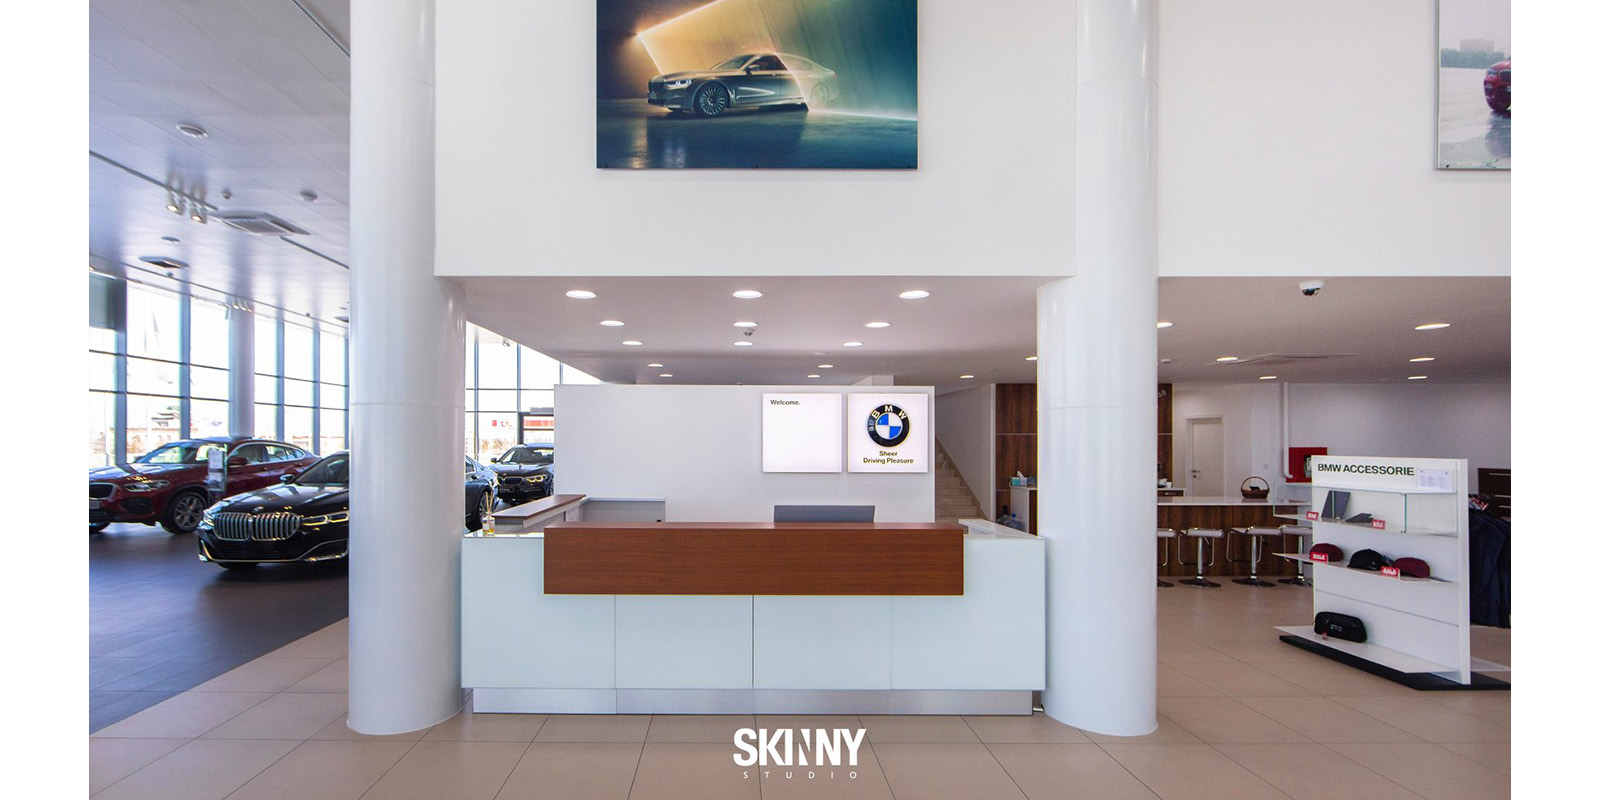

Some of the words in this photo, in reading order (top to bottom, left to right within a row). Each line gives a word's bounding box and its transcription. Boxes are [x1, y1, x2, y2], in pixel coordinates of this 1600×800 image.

[871, 405, 907, 420] BMW
[863, 457, 886, 465] Driving
[1317, 463, 1342, 473] BMW
[1343, 464, 1415, 477] ACCESSORIE
